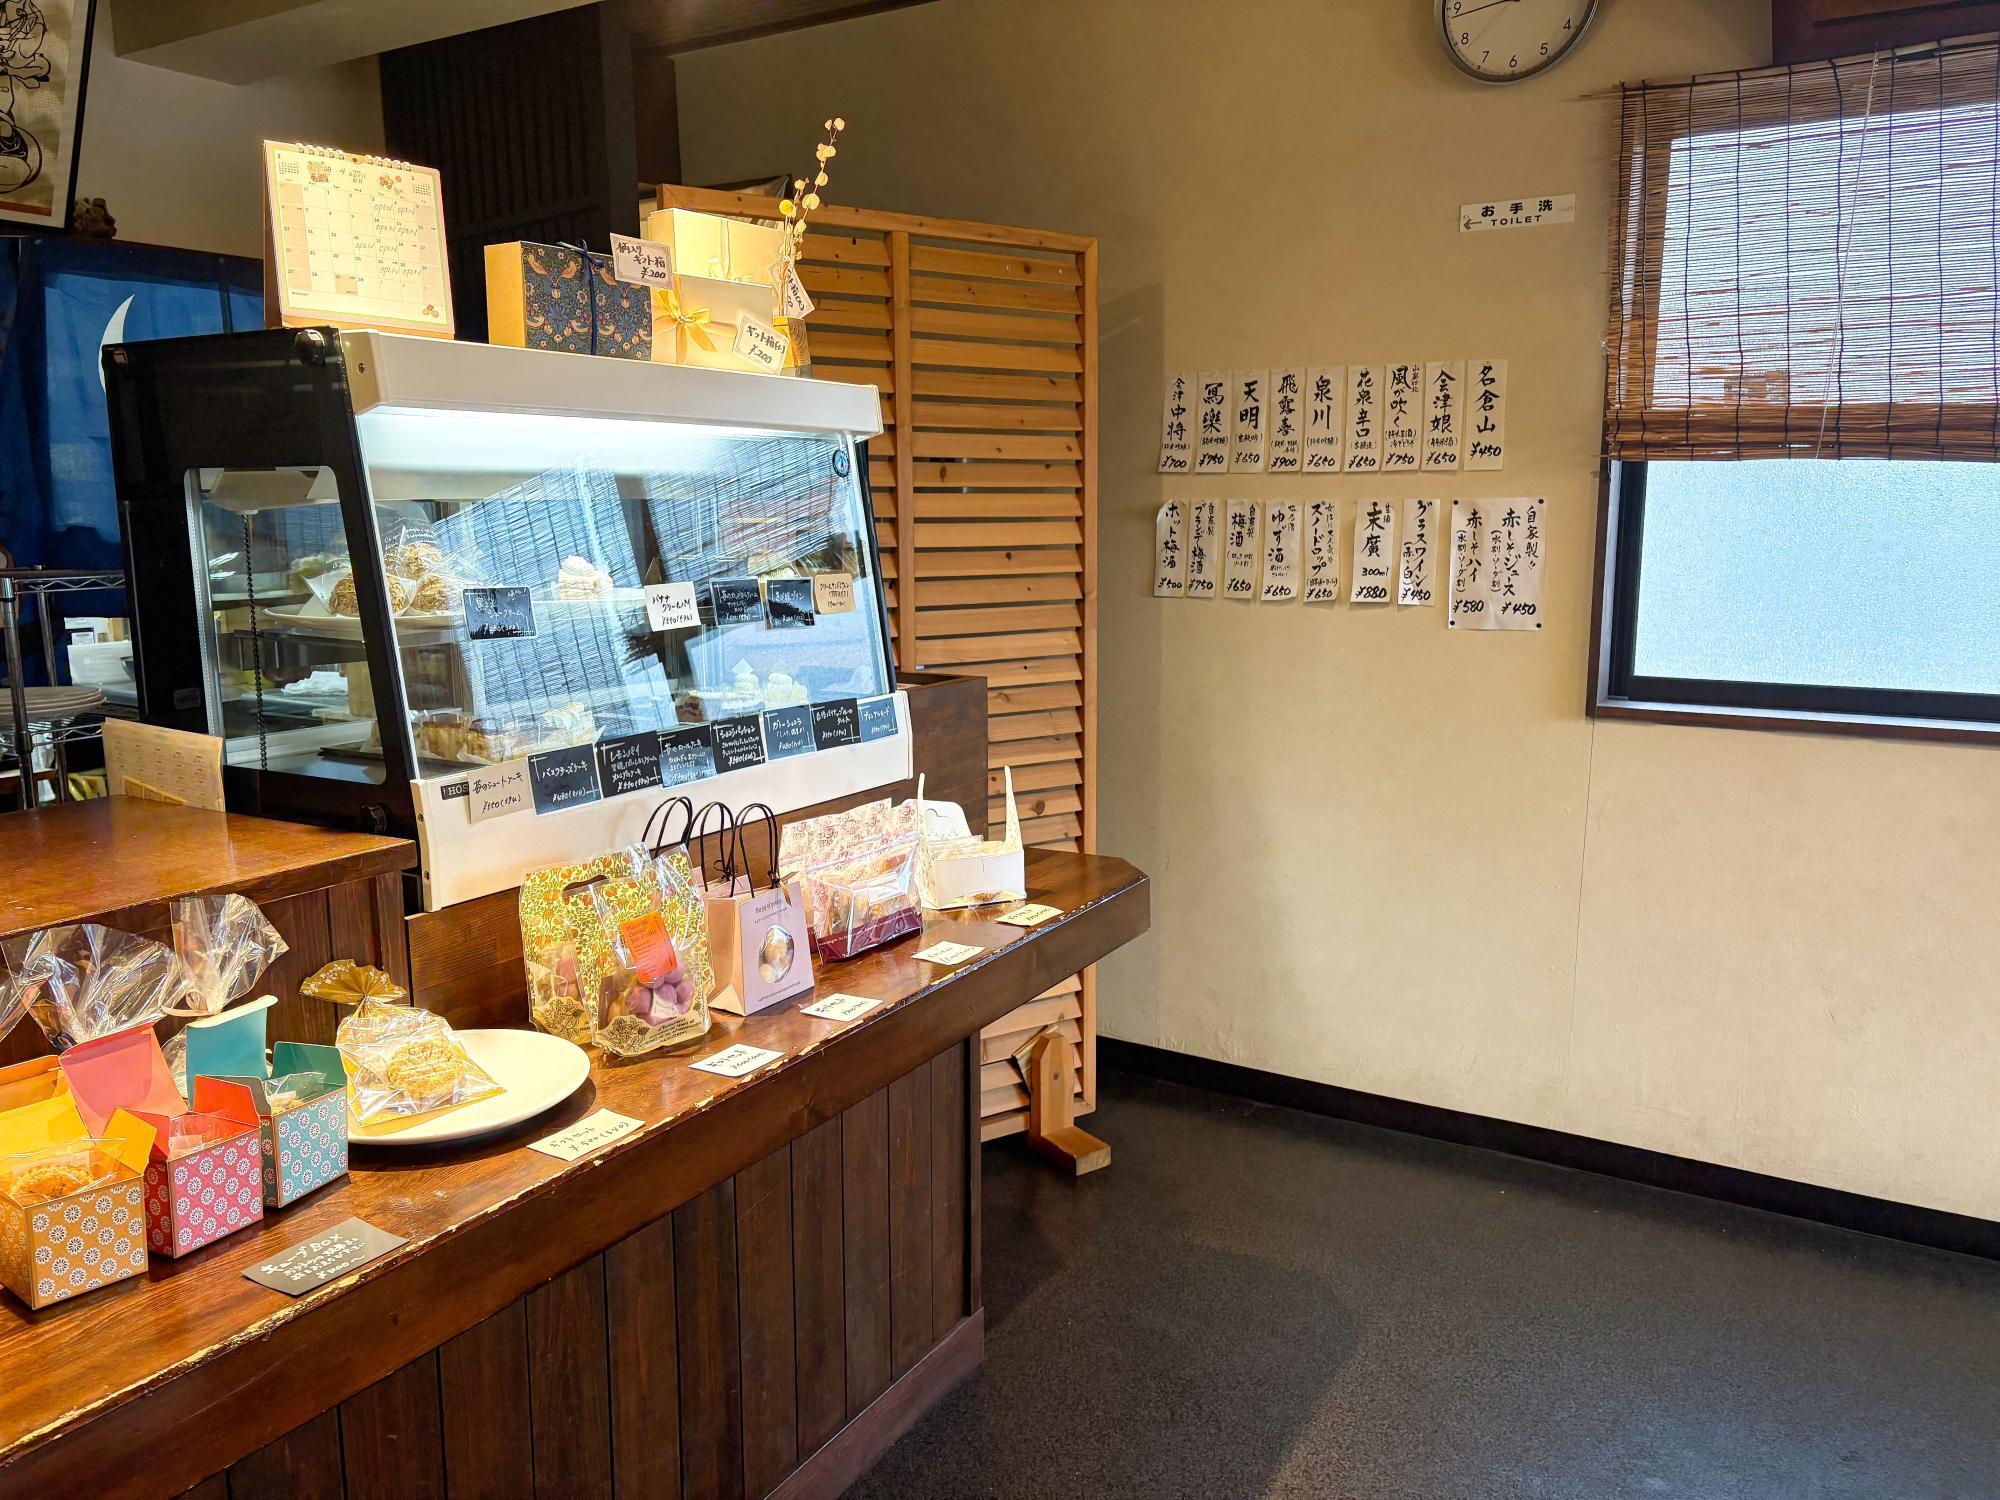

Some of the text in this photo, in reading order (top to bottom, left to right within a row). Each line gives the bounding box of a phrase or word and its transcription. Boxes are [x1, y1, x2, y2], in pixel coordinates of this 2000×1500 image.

[1453, 2, 1462, 14] 9
[1563, 18, 1571, 30] 4
[1461, 33, 1469, 44] 8
[1540, 43, 1548, 55] 5
[1482, 51, 1489, 63] 7
[1510, 55, 1517, 67] 6
[1481, 200, 1552, 217] お手洗
[1491, 215, 1542, 227] TOILET
[640, 267, 666, 278] ¥200
[748, 344, 772, 363] ¥200
[1312, 375, 1333, 430] 泉川
[1354, 369, 1373, 437] 花泉辛口
[1390, 365, 1411, 428] 風が吹く
[1430, 370, 1456, 433] 会津娘
[1476, 365, 1500, 433] 名倉山
[1240, 380, 1259, 429] 天明
[1235, 452, 1260, 464] ¥650
[1427, 451, 1456, 465] ¥650
[1470, 442, 1501, 460] ¥450
[1161, 455, 1187, 468] ¥700
[1199, 453, 1224, 467] ¥750
[1271, 457, 1297, 469] ¥900
[1307, 453, 1335, 468] ¥650
[1349, 455, 1376, 468] ¥650
[1386, 453, 1414, 465] ¥750
[1163, 503, 1180, 568] ホット梅酒
[1230, 512, 1246, 547] 梅酒
[1268, 510, 1286, 563] ゆず酒
[1312, 504, 1326, 576] スノードロップ
[1414, 501, 1432, 587] グラスワイン
[1466, 508, 1482, 582] 赤しそハイ
[1502, 507, 1521, 596] 赤しそジュース
[1362, 567, 1388, 576] 300ml
[1158, 577, 1182, 588] ¥500
[1188, 579, 1213, 591] ¥750
[1227, 578, 1251, 591] ¥650
[1264, 585, 1291, 596] ¥650
[1306, 588, 1332, 599] ¥650
[1355, 586, 1387, 598] ¥880
[1401, 588, 1431, 601] ¥450
[1453, 599, 1484, 613] ¥580
[1501, 602, 1536, 615] ¥450
[610, 744, 640, 762] レモンパイ
[542, 760, 588, 778] バスクチーズケーキ
[472, 772, 523, 795] 苺のショートケーキ
